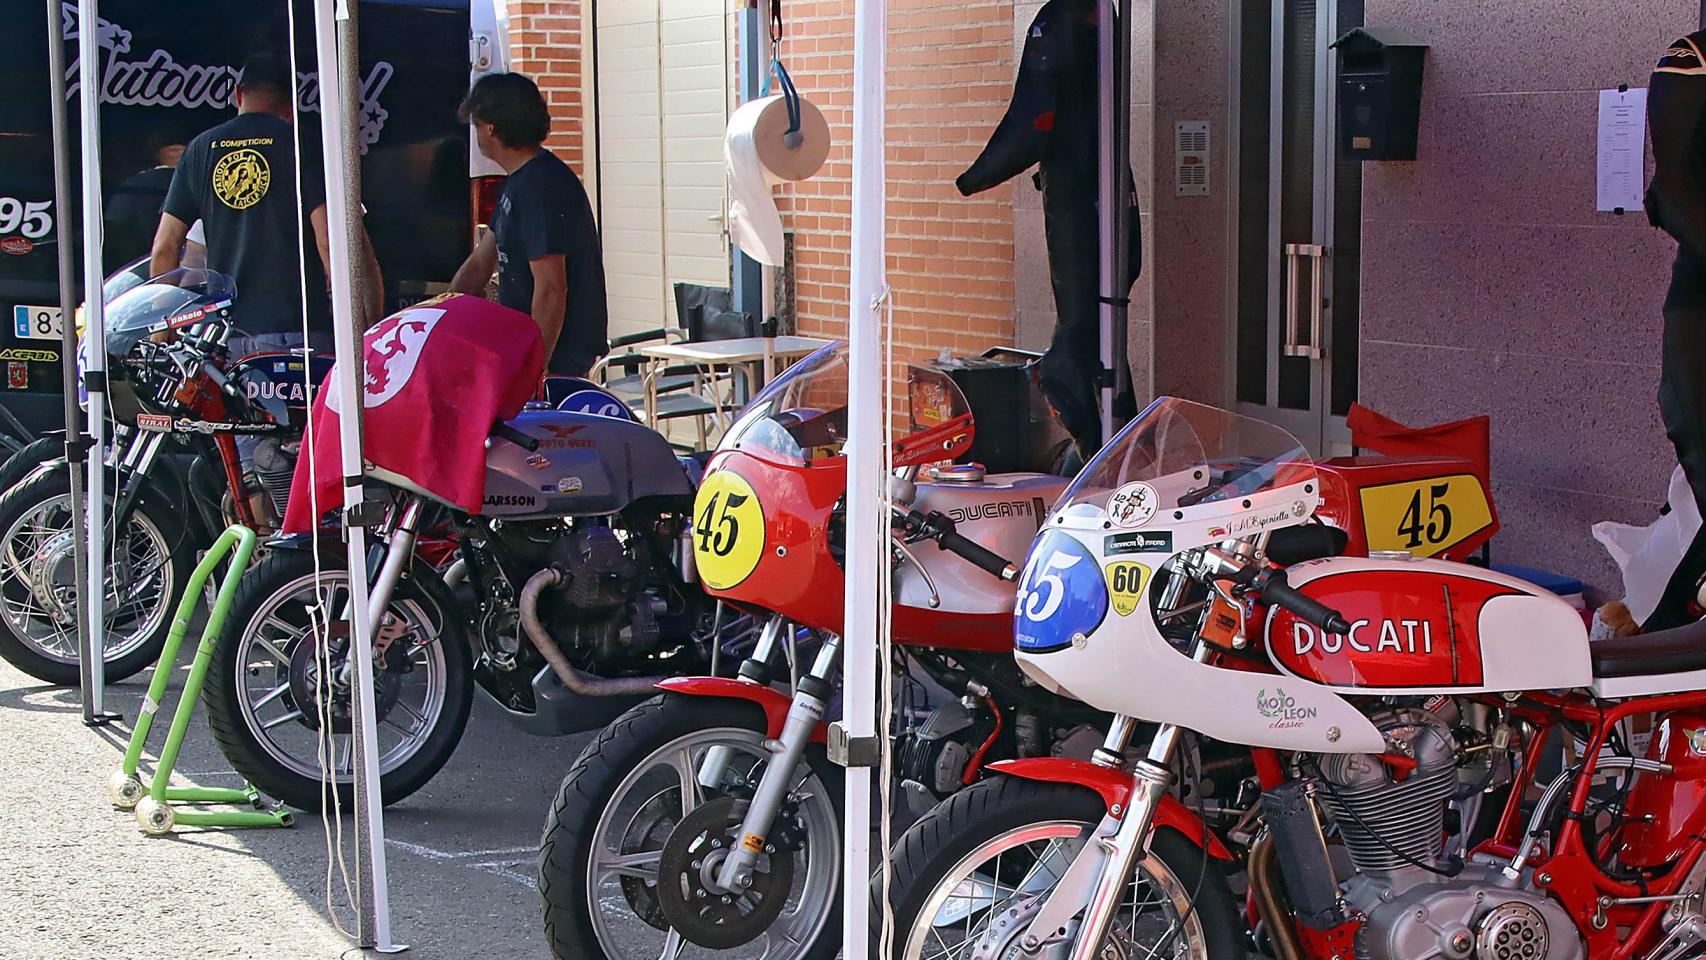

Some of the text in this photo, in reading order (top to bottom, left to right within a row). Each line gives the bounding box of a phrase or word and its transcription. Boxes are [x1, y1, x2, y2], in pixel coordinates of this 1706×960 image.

[221, 138, 273, 147] COMPETICION
[0, 197, 52, 238] 95
[247, 381, 322, 400] DUCAT
[483, 495, 535, 507] LARSSON
[948, 501, 1032, 523] DUCATI
[696, 491, 749, 557] 45
[1397, 482, 1452, 548] 45
[1015, 550, 1082, 622] 45
[1113, 565, 1141, 594] 60
[1294, 619, 1431, 655] DUCATI
[1257, 697, 1296, 709] MOTO
[1284, 707, 1317, 720] LEON
[1269, 717, 1304, 728] classic
